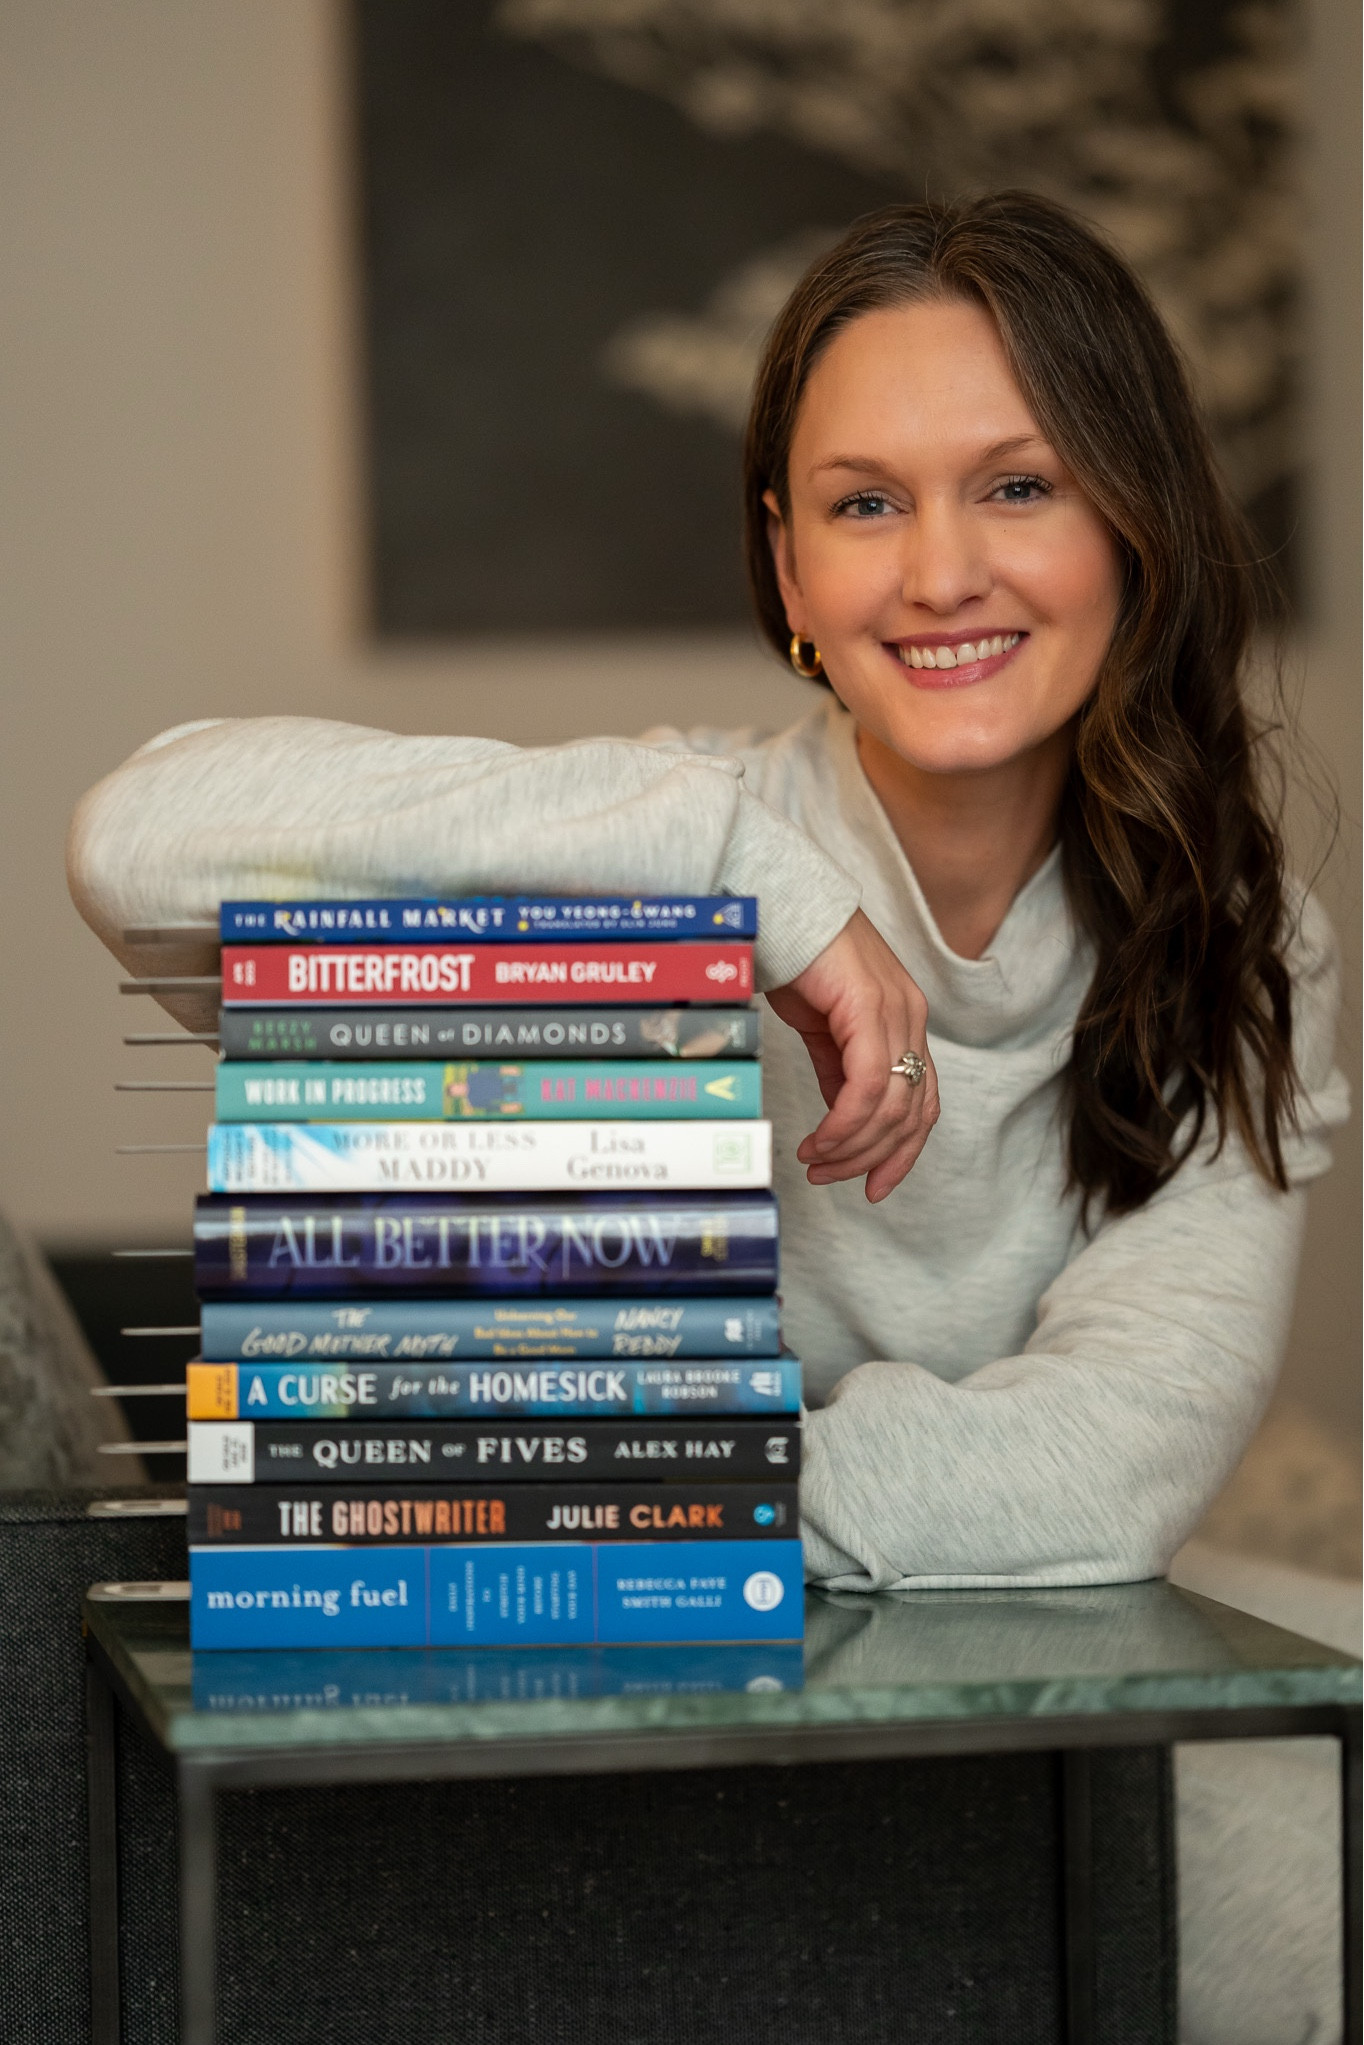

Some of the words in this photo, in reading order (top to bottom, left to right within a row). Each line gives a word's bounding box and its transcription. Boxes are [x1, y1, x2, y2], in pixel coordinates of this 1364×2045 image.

[273, 909, 392, 936] RAINFALL
[402, 908, 505, 935] MARKET
[518, 905, 556, 919] YOU
[287, 954, 475, 992] BITTERFROST
[495, 961, 567, 983] BRYAN
[570, 961, 656, 983] GRULEY
[329, 1023, 430, 1047] QUEEN
[462, 1022, 626, 1045] DIAMONDS
[244, 1078, 300, 1106] WORK
[304, 1078, 327, 1106] IN
[332, 1077, 427, 1105] PROGRESS
[541, 1078, 576, 1101] KAT
[585, 1077, 697, 1101] MACKENZIE
[332, 1128, 410, 1151] MORE
[420, 1129, 458, 1151] OR
[468, 1128, 537, 1151] LESS
[590, 1130, 646, 1153] Lisa
[379, 1158, 488, 1182] MADDY
[566, 1156, 669, 1180] Genova
[267, 1215, 360, 1268] ALL
[373, 1215, 549, 1272] BETTER
[562, 1214, 682, 1280] NOW
[614, 1306, 685, 1332] NANCY
[241, 1327, 308, 1358] GOOD
[309, 1332, 393, 1357] MOTHER
[394, 1333, 460, 1357] MYTH
[612, 1332, 683, 1358] REDDY
[247, 1375, 268, 1406] A
[277, 1373, 378, 1405] CURSE
[388, 1375, 424, 1400] for
[428, 1375, 460, 1396] the
[469, 1370, 628, 1402] HOMESICK
[637, 1370, 682, 1386] LAURA
[685, 1369, 742, 1385] BROOKE
[268, 1443, 304, 1459] THE
[312, 1439, 432, 1469] QUEEN
[441, 1442, 467, 1458] OF
[476, 1436, 588, 1464] FIVES
[614, 1440, 679, 1459] ALEX
[685, 1440, 737, 1459] HAY
[278, 1501, 323, 1537] THE
[332, 1500, 506, 1536] GHOSTWRITER
[546, 1504, 620, 1530] JULIE
[629, 1503, 725, 1529] CLARK
[616, 1578, 687, 1592] REBECCA
[206, 1584, 341, 1617] morning
[350, 1579, 409, 1607] fuel
[622, 1596, 672, 1609] SMITH
